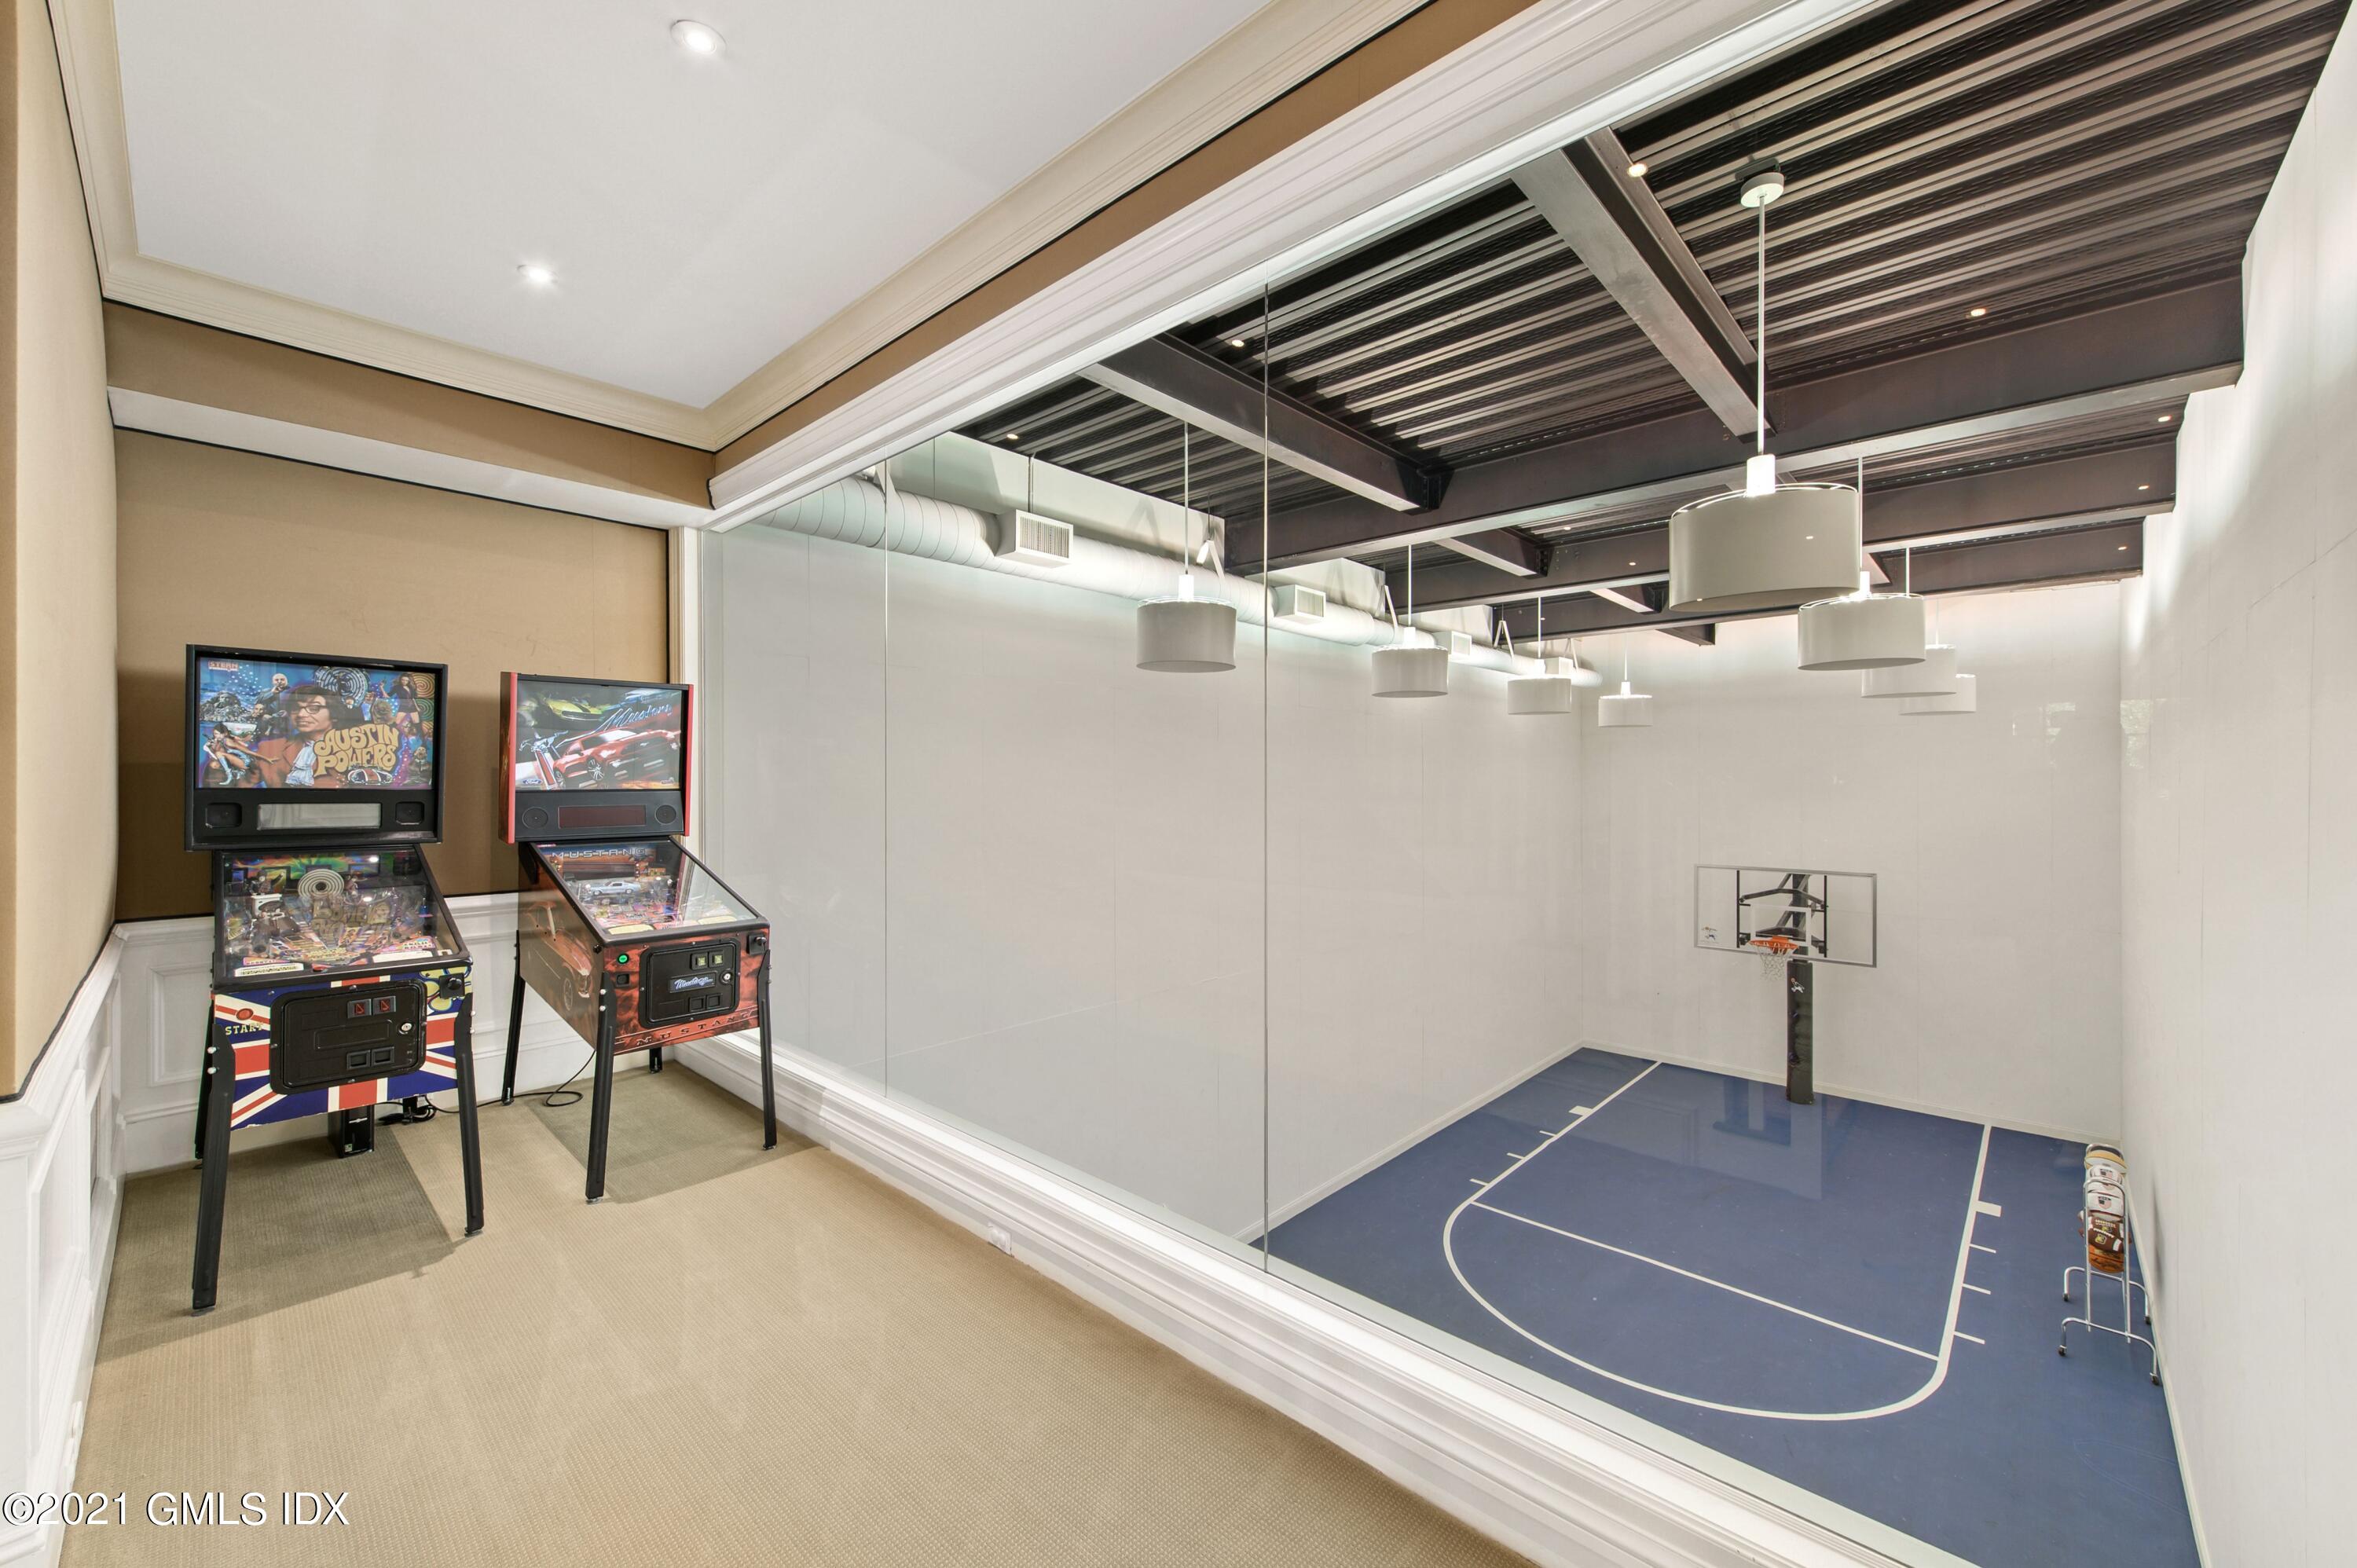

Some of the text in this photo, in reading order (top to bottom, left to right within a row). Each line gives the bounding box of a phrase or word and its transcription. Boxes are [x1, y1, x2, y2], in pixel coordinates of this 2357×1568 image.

[313, 724, 399, 757] AUSTIN
[313, 743, 397, 777] POWERS
[225, 1022, 263, 1035] START
